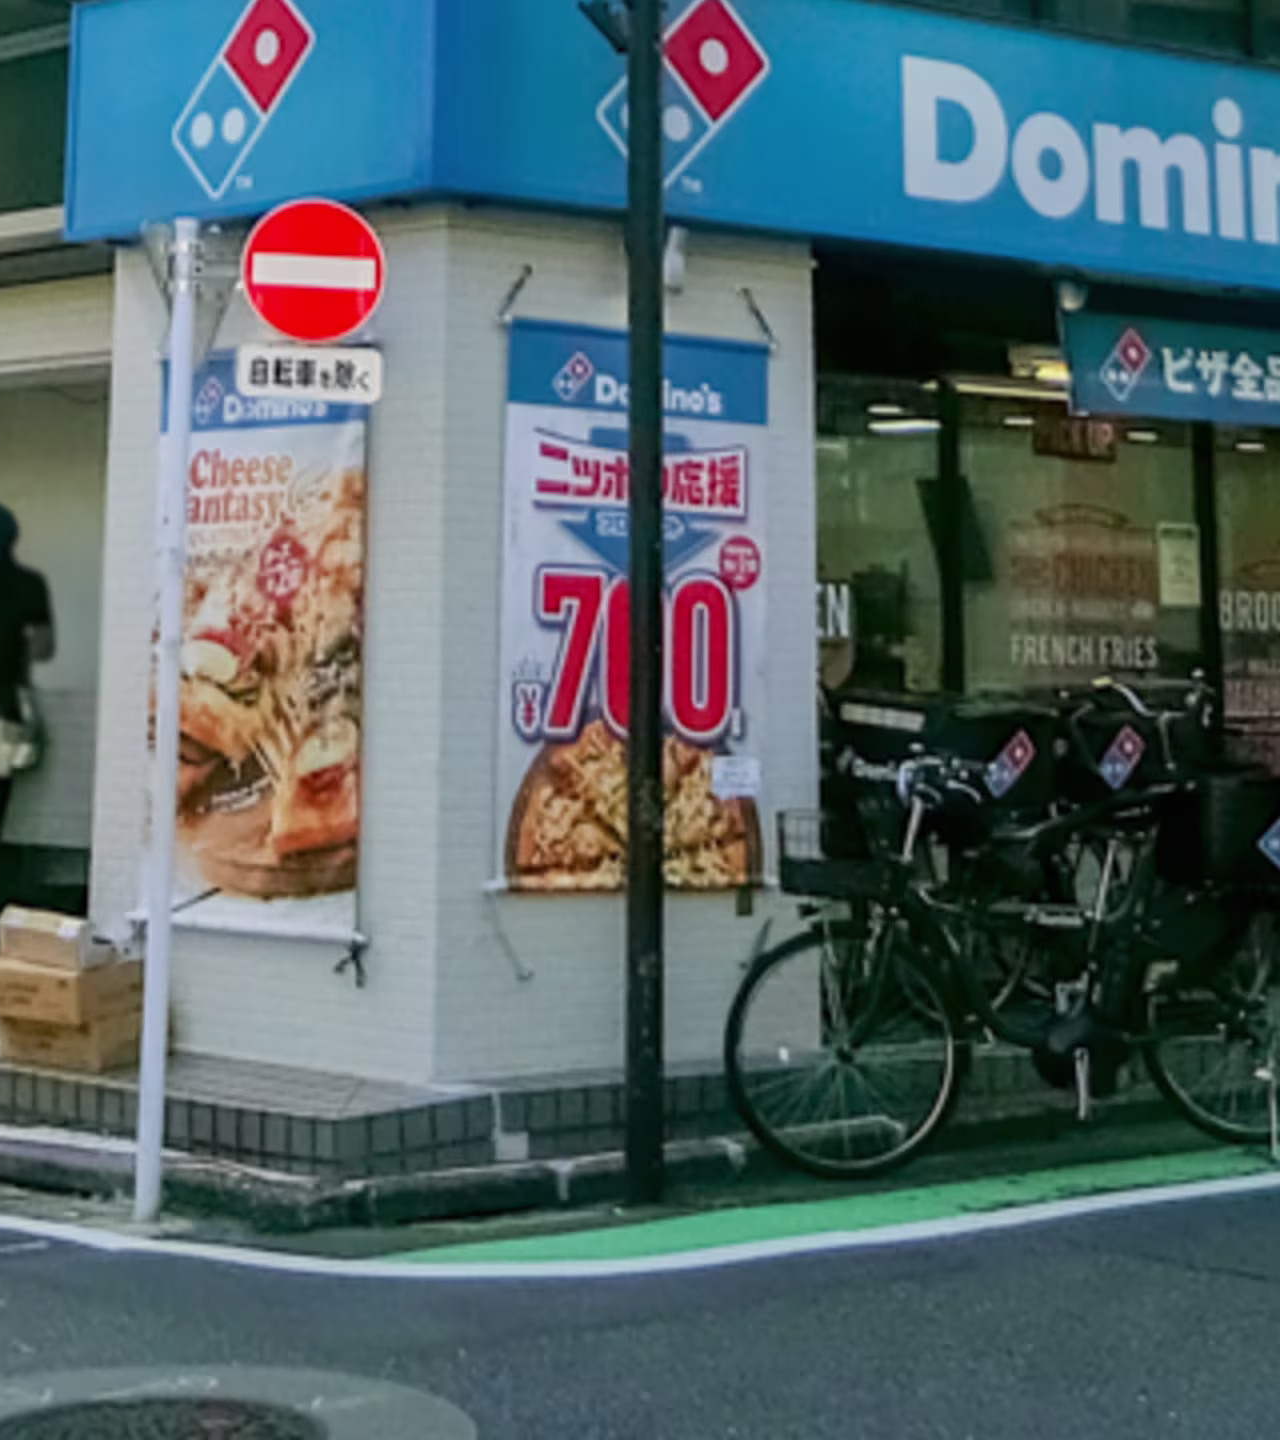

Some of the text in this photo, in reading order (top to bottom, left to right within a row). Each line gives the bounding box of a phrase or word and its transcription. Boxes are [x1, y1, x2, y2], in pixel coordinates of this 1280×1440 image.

[249, 357, 370, 392] 自転車を除く
[594, 375, 724, 414] Doino's
[188, 447, 294, 489] Cheese
[184, 490, 284, 529] antasy
[1010, 634, 1158, 668] FRENCH FRIES
